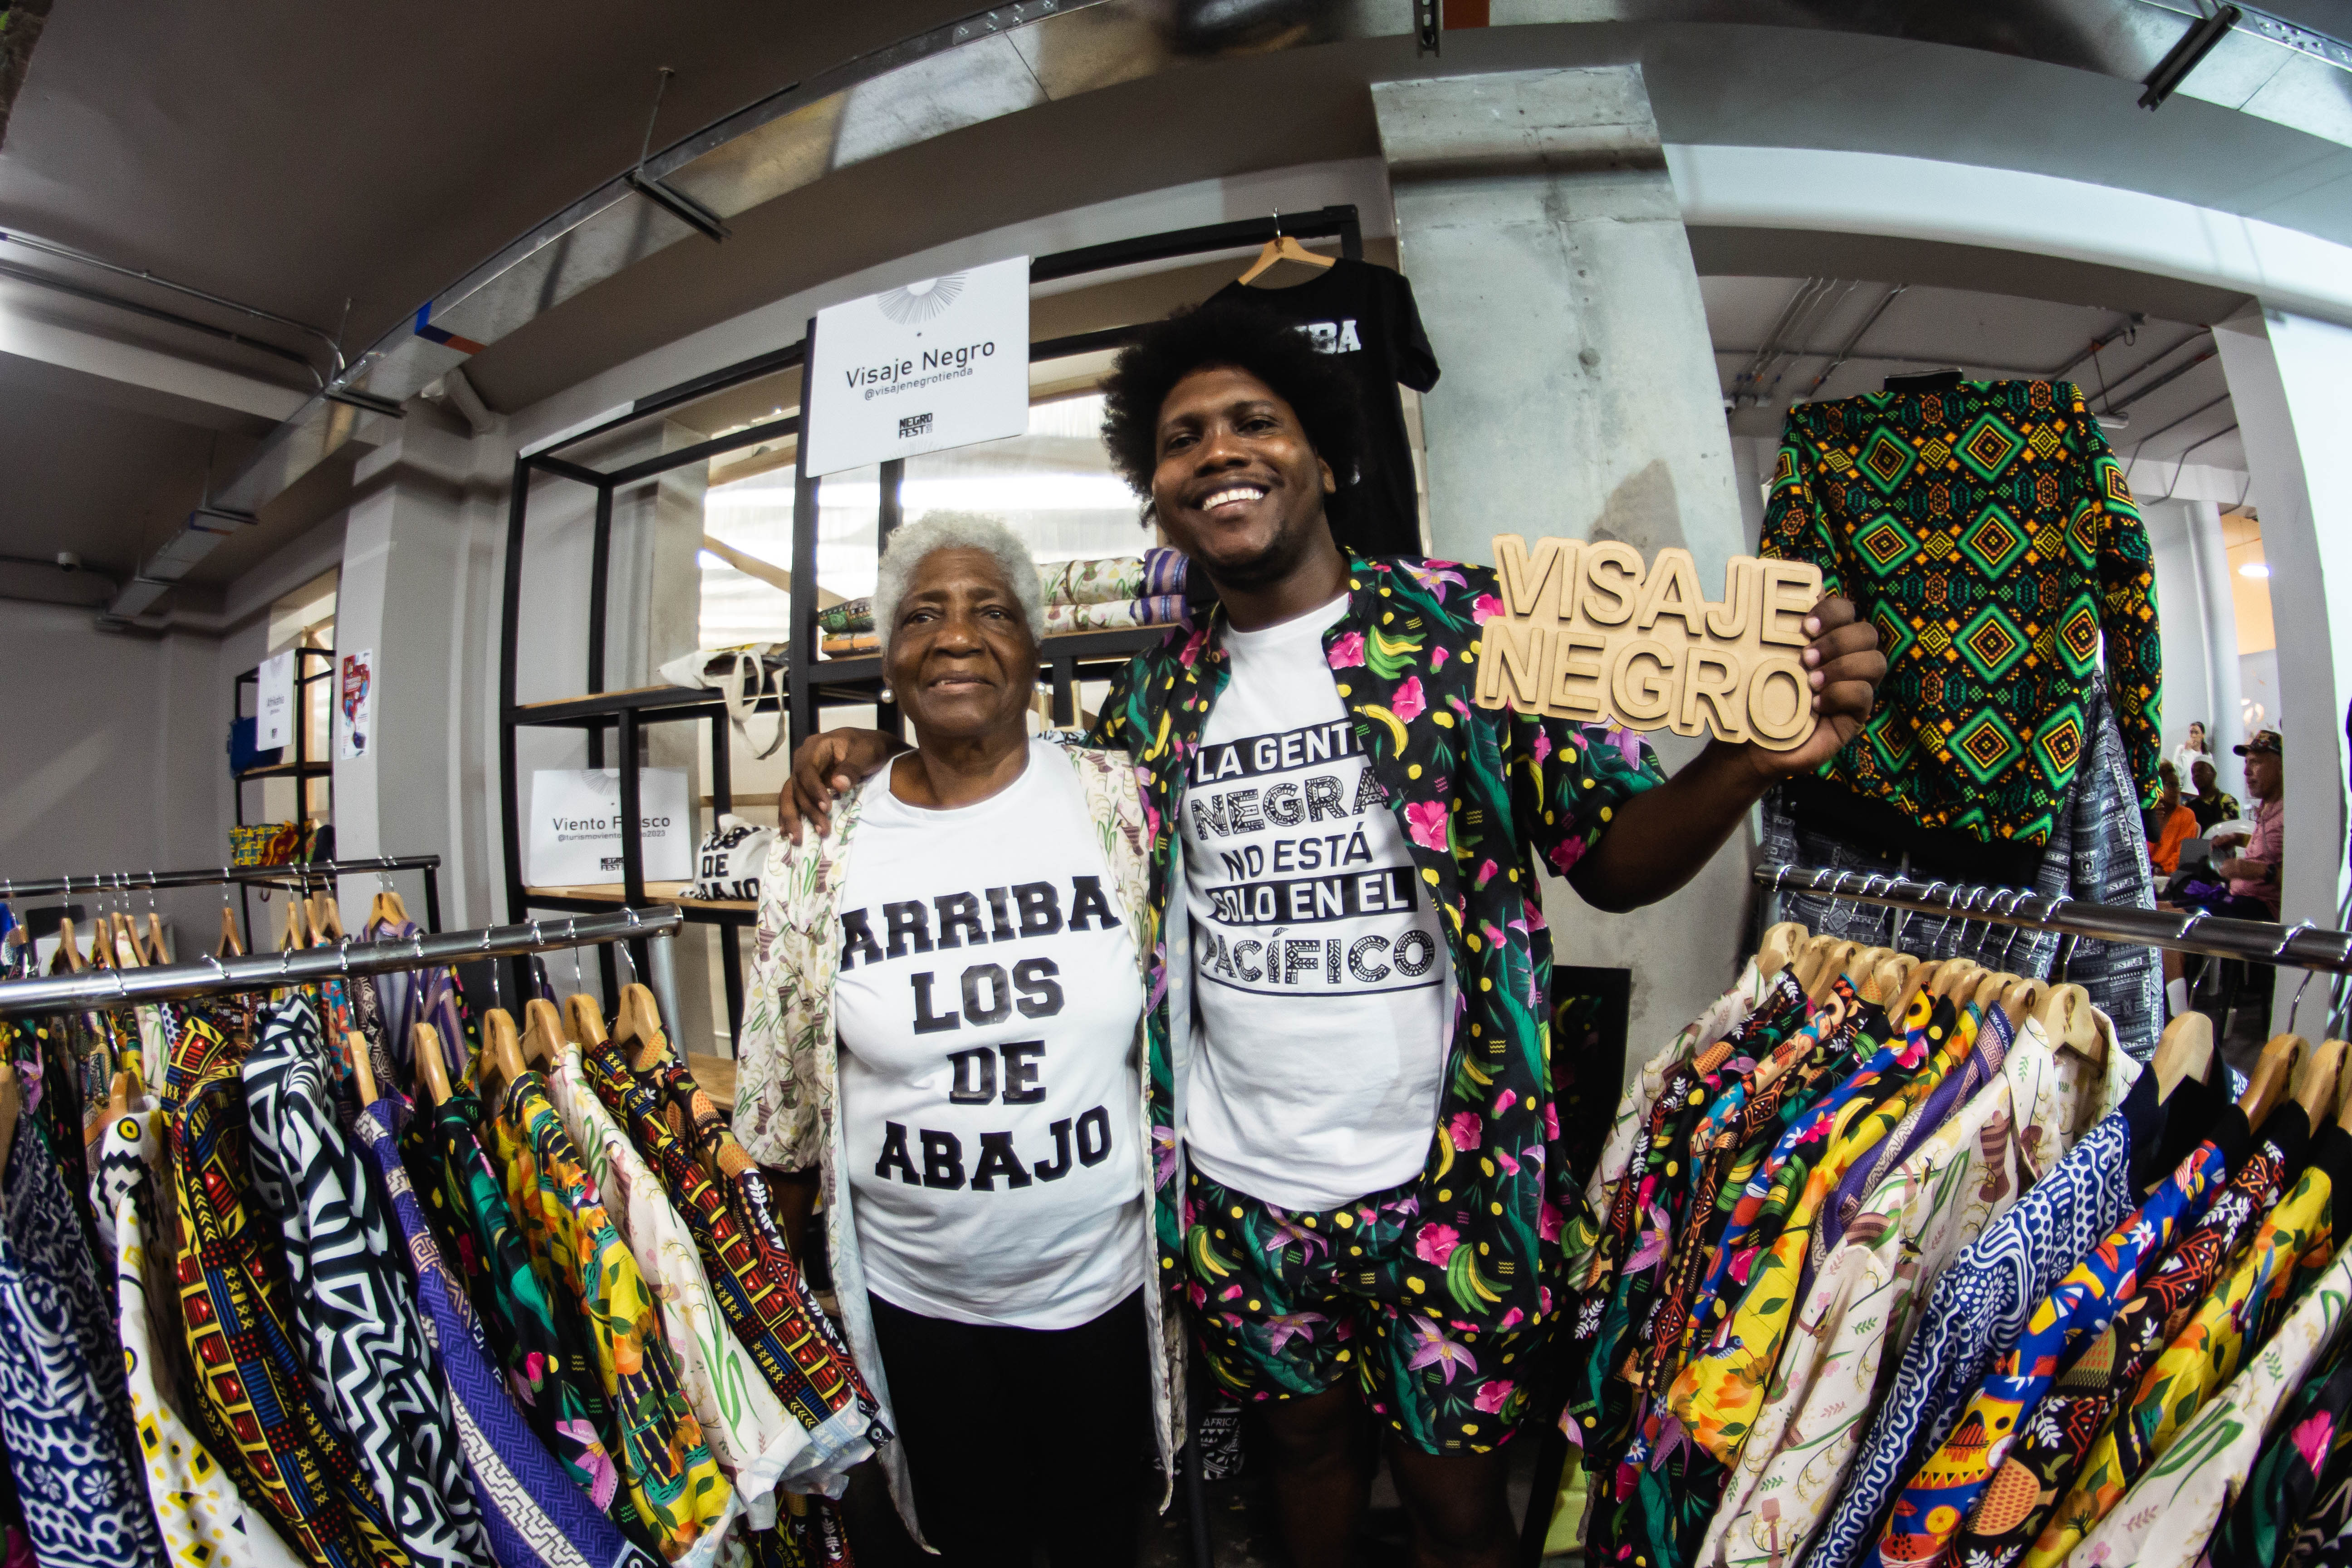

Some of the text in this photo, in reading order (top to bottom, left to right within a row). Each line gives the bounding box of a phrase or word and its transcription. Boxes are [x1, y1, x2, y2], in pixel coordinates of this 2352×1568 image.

[846, 341, 995, 389] Visaje Negro
[864, 367, 973, 401] @visajenegrotienda
[899, 413, 933, 429] NEGRO
[899, 425, 926, 439] FEST
[1500, 541, 1817, 647] VISAJE
[1485, 624, 1811, 740] NEGRO
[1196, 721, 1365, 783] LA GENT
[553, 816, 671, 831] Viento Fsco
[1190, 765, 1389, 841] NEGRA
[702, 853, 730, 878] DE
[1220, 822, 1373, 882] NO ESTÁ
[839, 875, 1122, 973] ARRIBA
[1211, 872, 1409, 922] SOLO EN EL
[910, 957, 1065, 1035] LOS
[946, 1039, 1047, 1106] DE
[875, 1104, 1113, 1192] ABAJO
